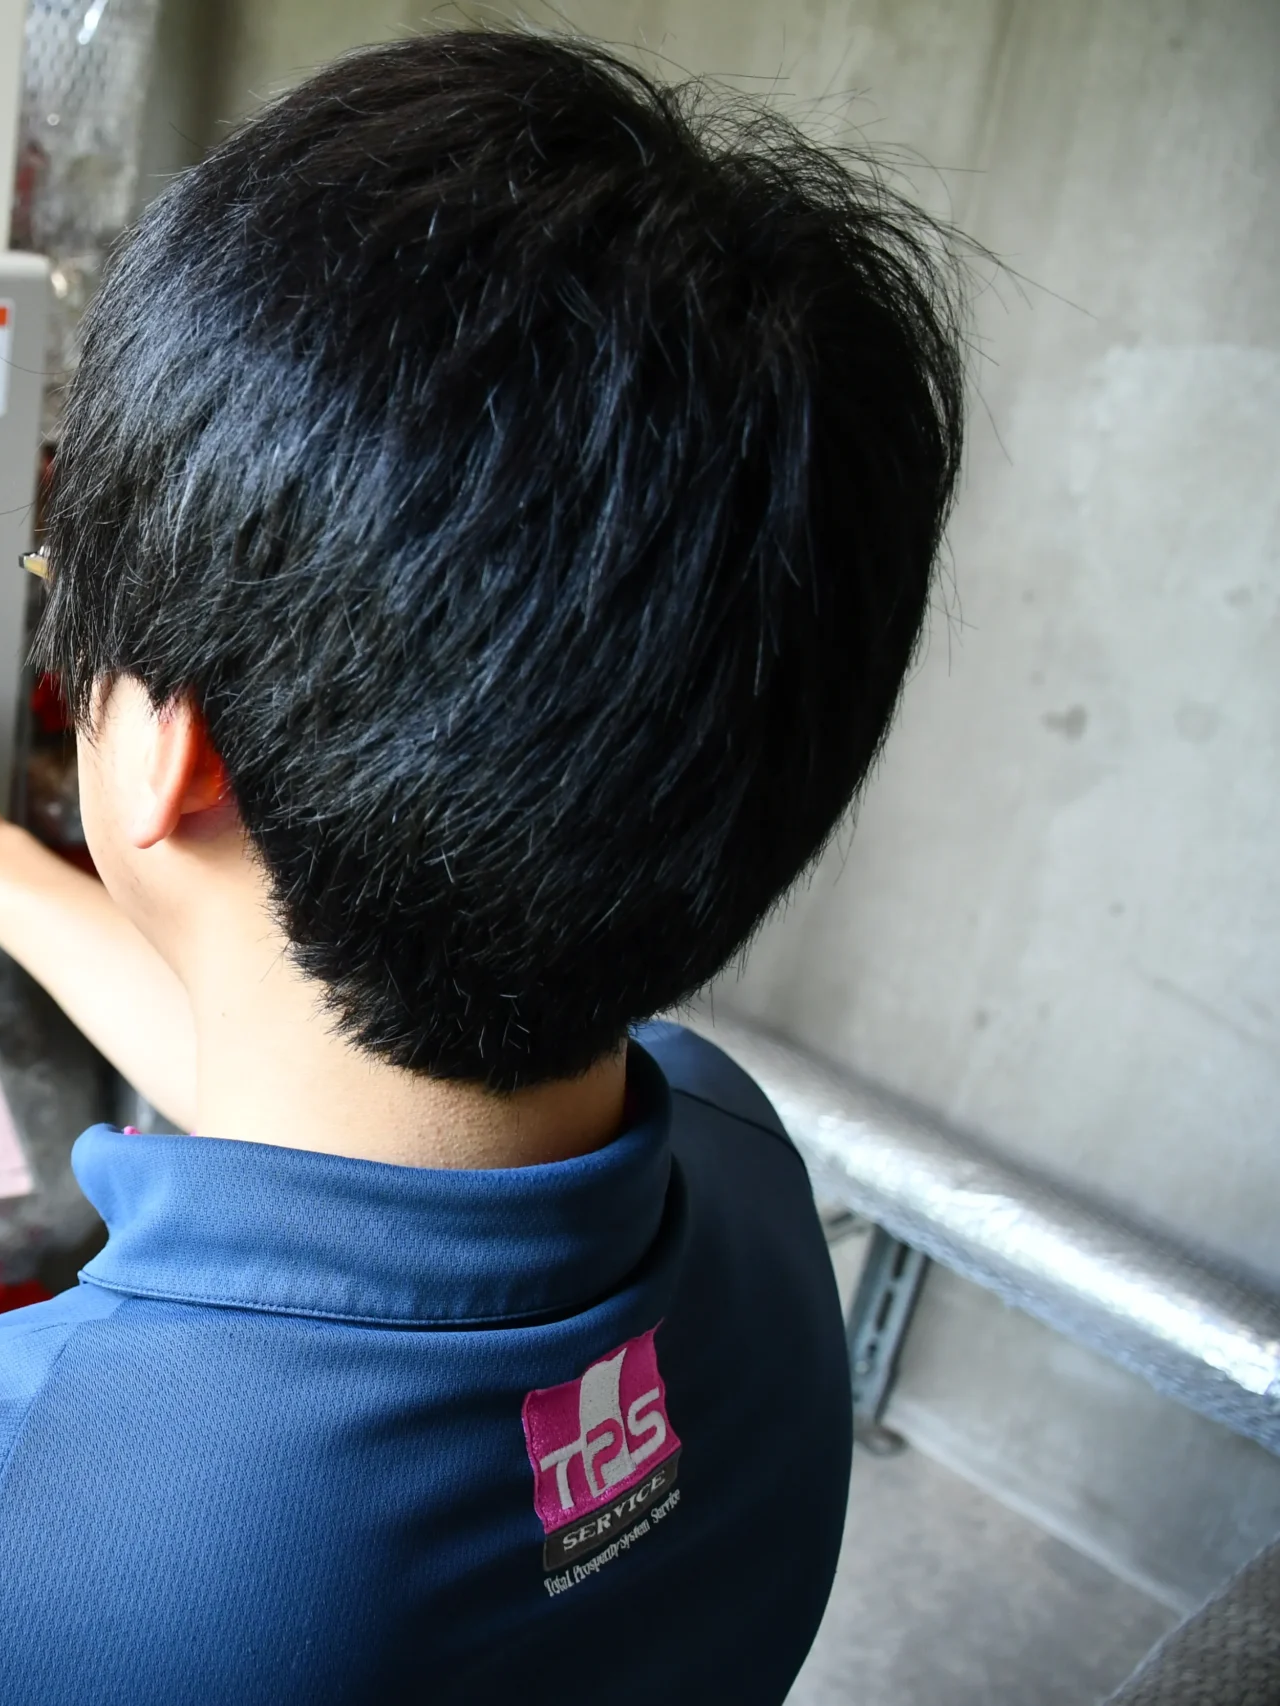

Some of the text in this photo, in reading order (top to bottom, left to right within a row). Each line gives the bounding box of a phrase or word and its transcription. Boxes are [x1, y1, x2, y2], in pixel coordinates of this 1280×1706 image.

[539, 1384, 667, 1511] TPS
[543, 1569, 575, 1598] Total
[619, 1518, 651, 1550] System
[649, 1488, 681, 1524] Service
[562, 1469, 666, 1552] SERVICE
